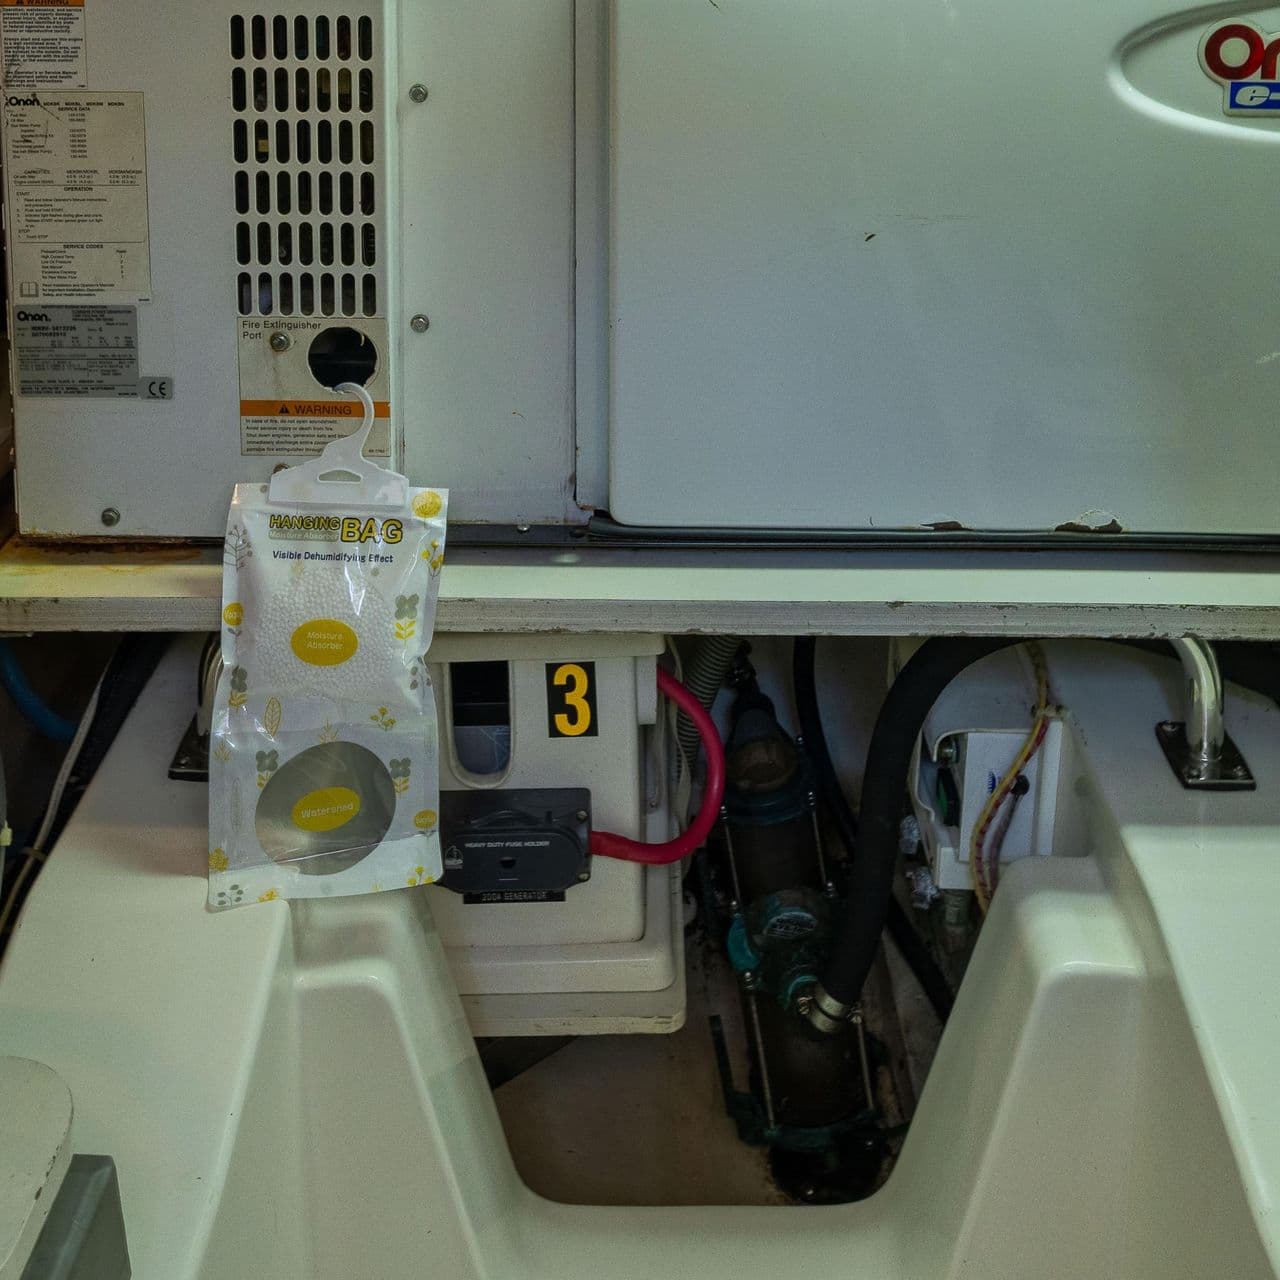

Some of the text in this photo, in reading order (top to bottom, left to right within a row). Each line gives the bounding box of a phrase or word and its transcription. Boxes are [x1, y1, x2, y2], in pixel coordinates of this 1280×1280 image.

[9, 96, 40, 106] Onan
[17, 310, 48, 321] Onan
[242, 320, 321, 330] Fire Extinguisher
[243, 331, 262, 339] Port
[149, 382, 166, 395] CE
[294, 405, 352, 415] WARNING
[269, 514, 404, 544] HANGING BAG
[273, 550, 393, 563] Visible Dehumidifying Effect
[307, 632, 343, 640] Moisture
[306, 642, 343, 650] Absorber
[553, 663, 591, 736] 3
[300, 803, 353, 818] Watershed
